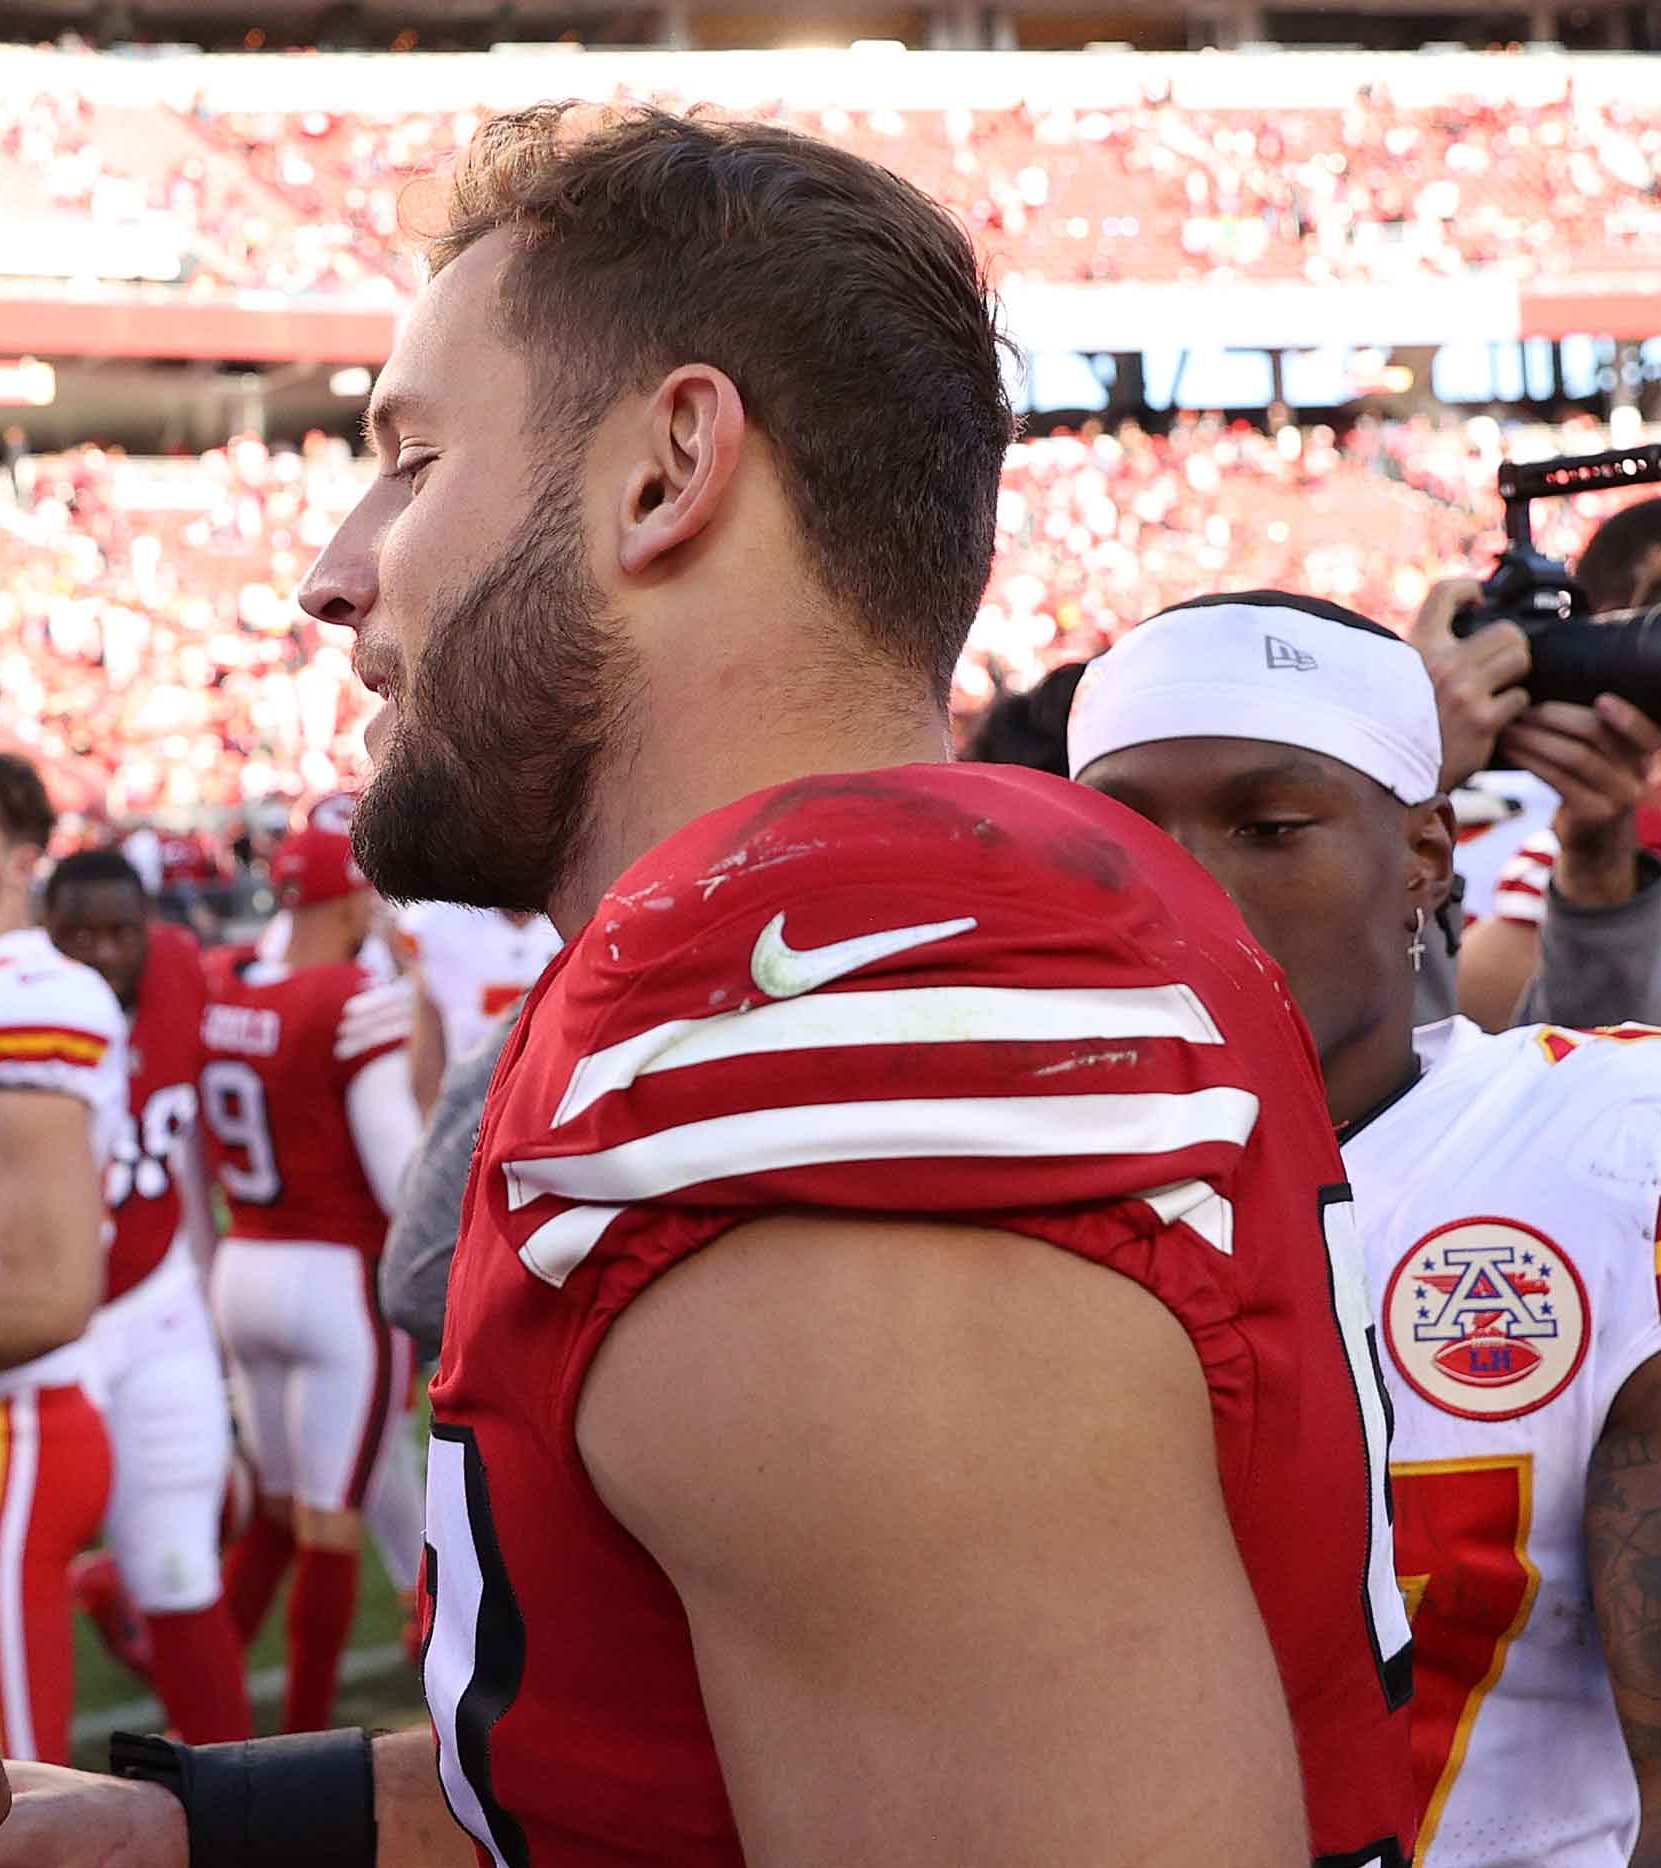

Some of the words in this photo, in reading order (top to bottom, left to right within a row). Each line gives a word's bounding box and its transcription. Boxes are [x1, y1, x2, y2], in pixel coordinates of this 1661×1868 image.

[199, 1060, 283, 1205] 9
[1414, 1247, 1558, 1341] A
[1469, 1349, 1513, 1372] LH
